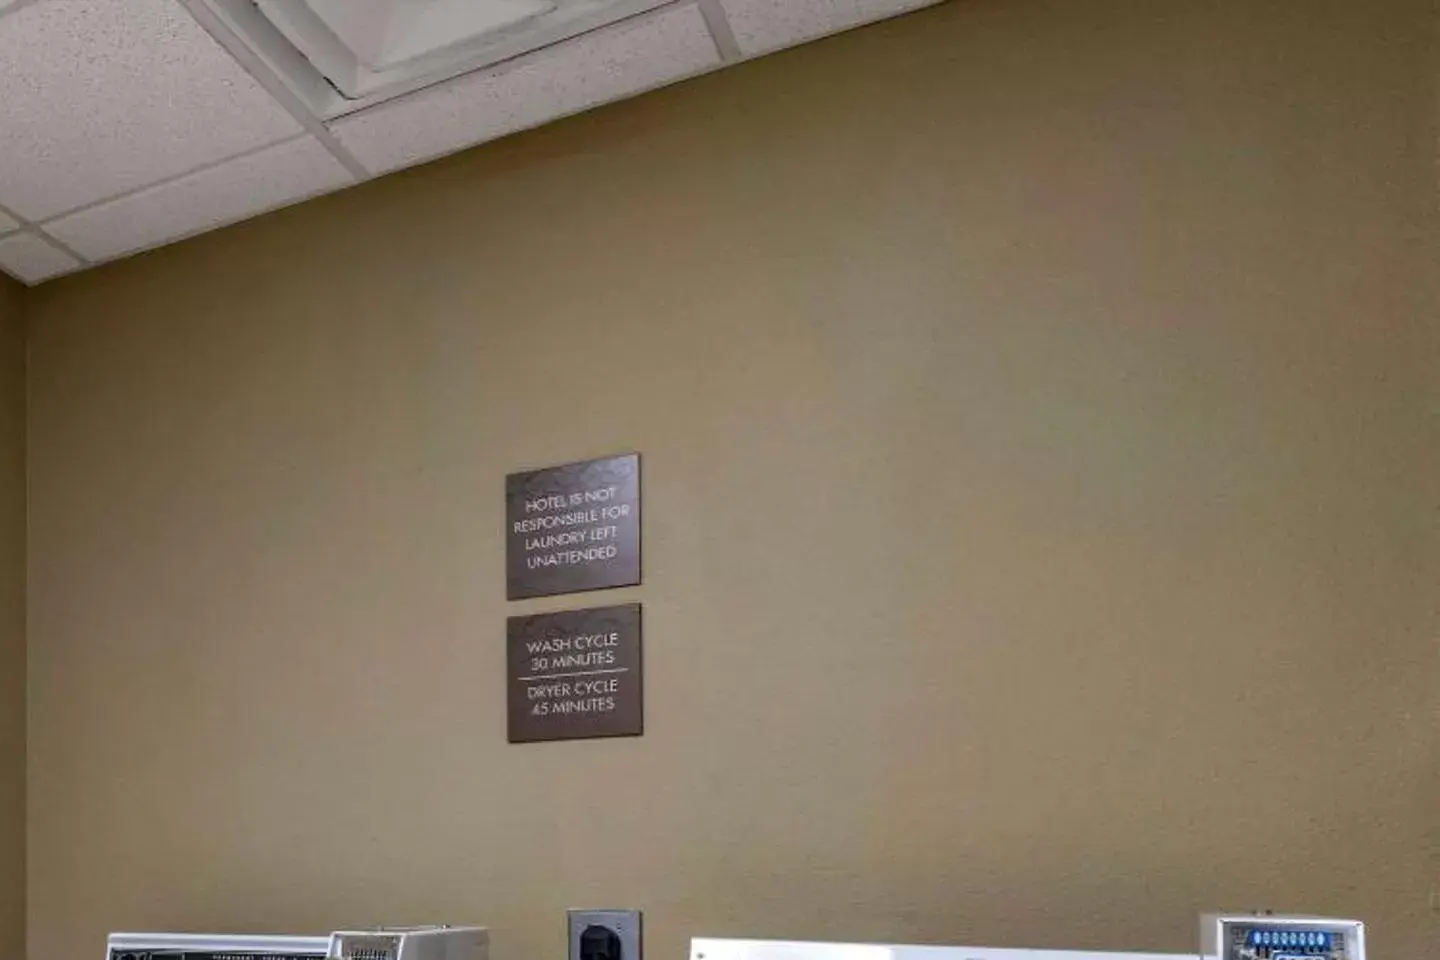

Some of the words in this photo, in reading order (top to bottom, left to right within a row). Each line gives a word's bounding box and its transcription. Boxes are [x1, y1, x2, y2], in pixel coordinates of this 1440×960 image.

[526, 495, 567, 513] HOTEL
[570, 492, 583, 505] IS
[584, 487, 616, 502] NOT
[514, 509, 598, 533] RESPONSIBLE
[602, 504, 631, 520] FOR
[525, 531, 587, 550] LAUNDRY
[591, 525, 617, 541] LEFT
[527, 545, 618, 569] UNATTENDED
[526, 638, 571, 654] WASH
[575, 632, 619, 650] CYCLE
[531, 657, 548, 671] 30
[552, 650, 616, 668] MINUTES
[527, 683, 571, 700] DRYER
[574, 679, 619, 695] CYCLE
[531, 702, 549, 716] 45
[552, 696, 616, 713] MINUTES
